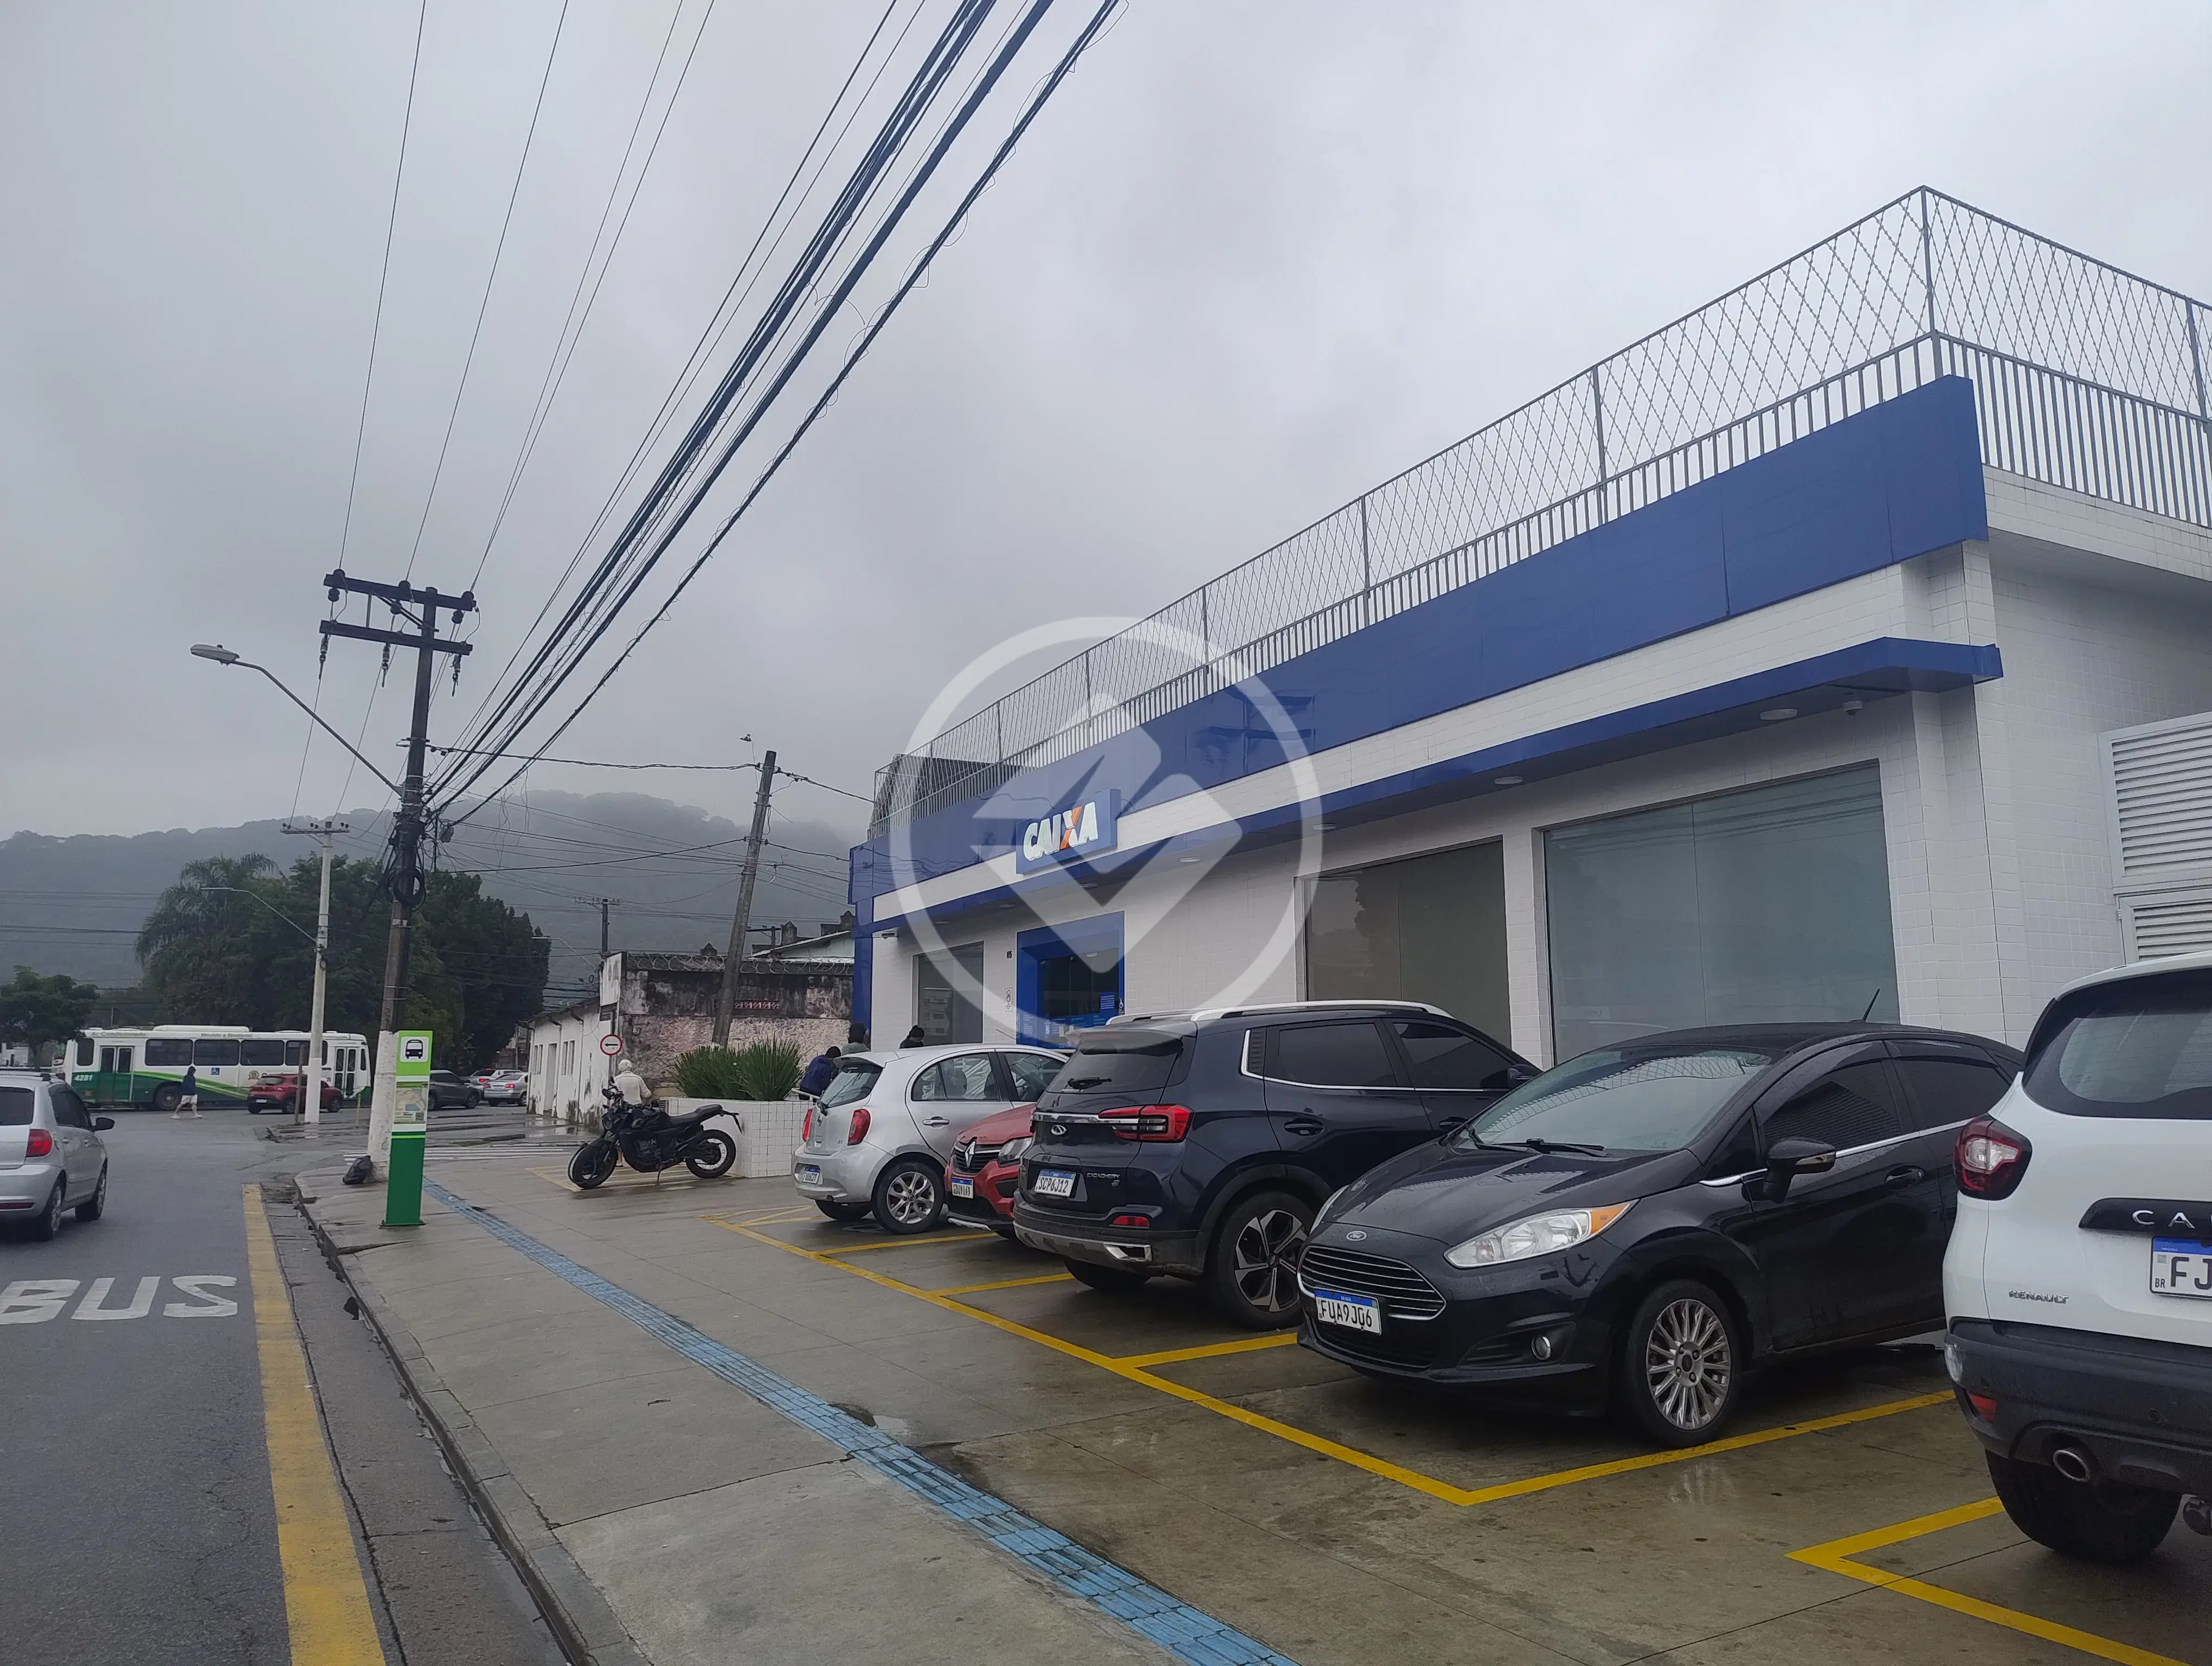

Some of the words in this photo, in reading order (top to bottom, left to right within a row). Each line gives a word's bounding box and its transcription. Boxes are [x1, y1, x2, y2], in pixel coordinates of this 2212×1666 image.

[1024, 802, 1098, 861] CAIXA
[1038, 1176, 1069, 1193] SCP6J12
[2132, 1210, 2212, 1229] CA
[2155, 1278, 2165, 1289] BR
[0, 1275, 238, 1325] BUS
[2008, 1289, 2069, 1304] RENAULT
